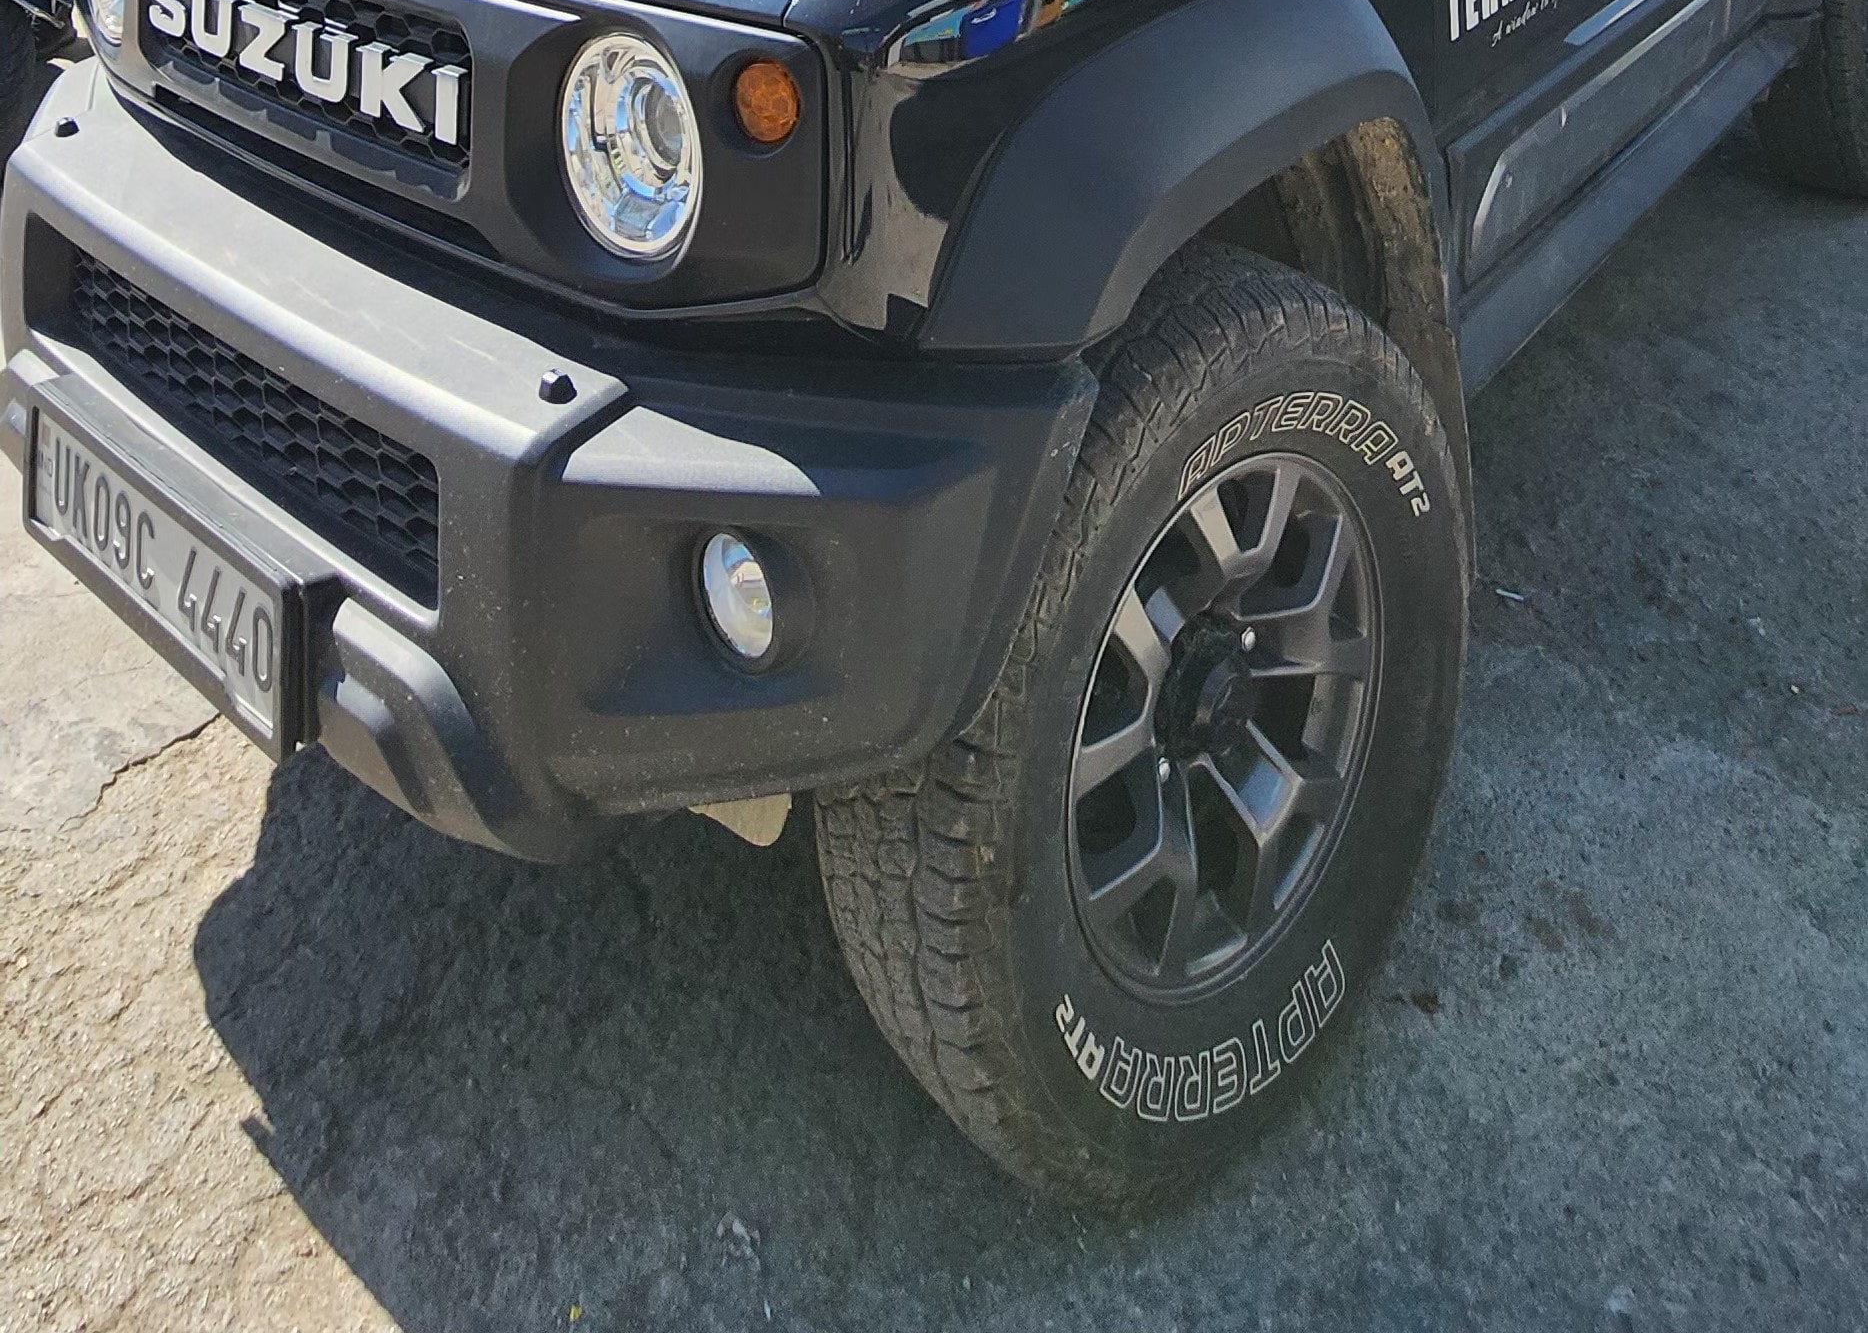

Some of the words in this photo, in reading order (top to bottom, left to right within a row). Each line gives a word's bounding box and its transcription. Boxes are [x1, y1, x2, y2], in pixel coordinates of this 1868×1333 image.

[1177, 391, 1399, 501] APTERRA
[1385, 450, 1431, 517] AT2
[53, 436, 155, 590] UK09C
[177, 546, 274, 693] 4440
[1055, 994, 1105, 1081] AT2
[1100, 939, 1346, 1122] APTERRA
